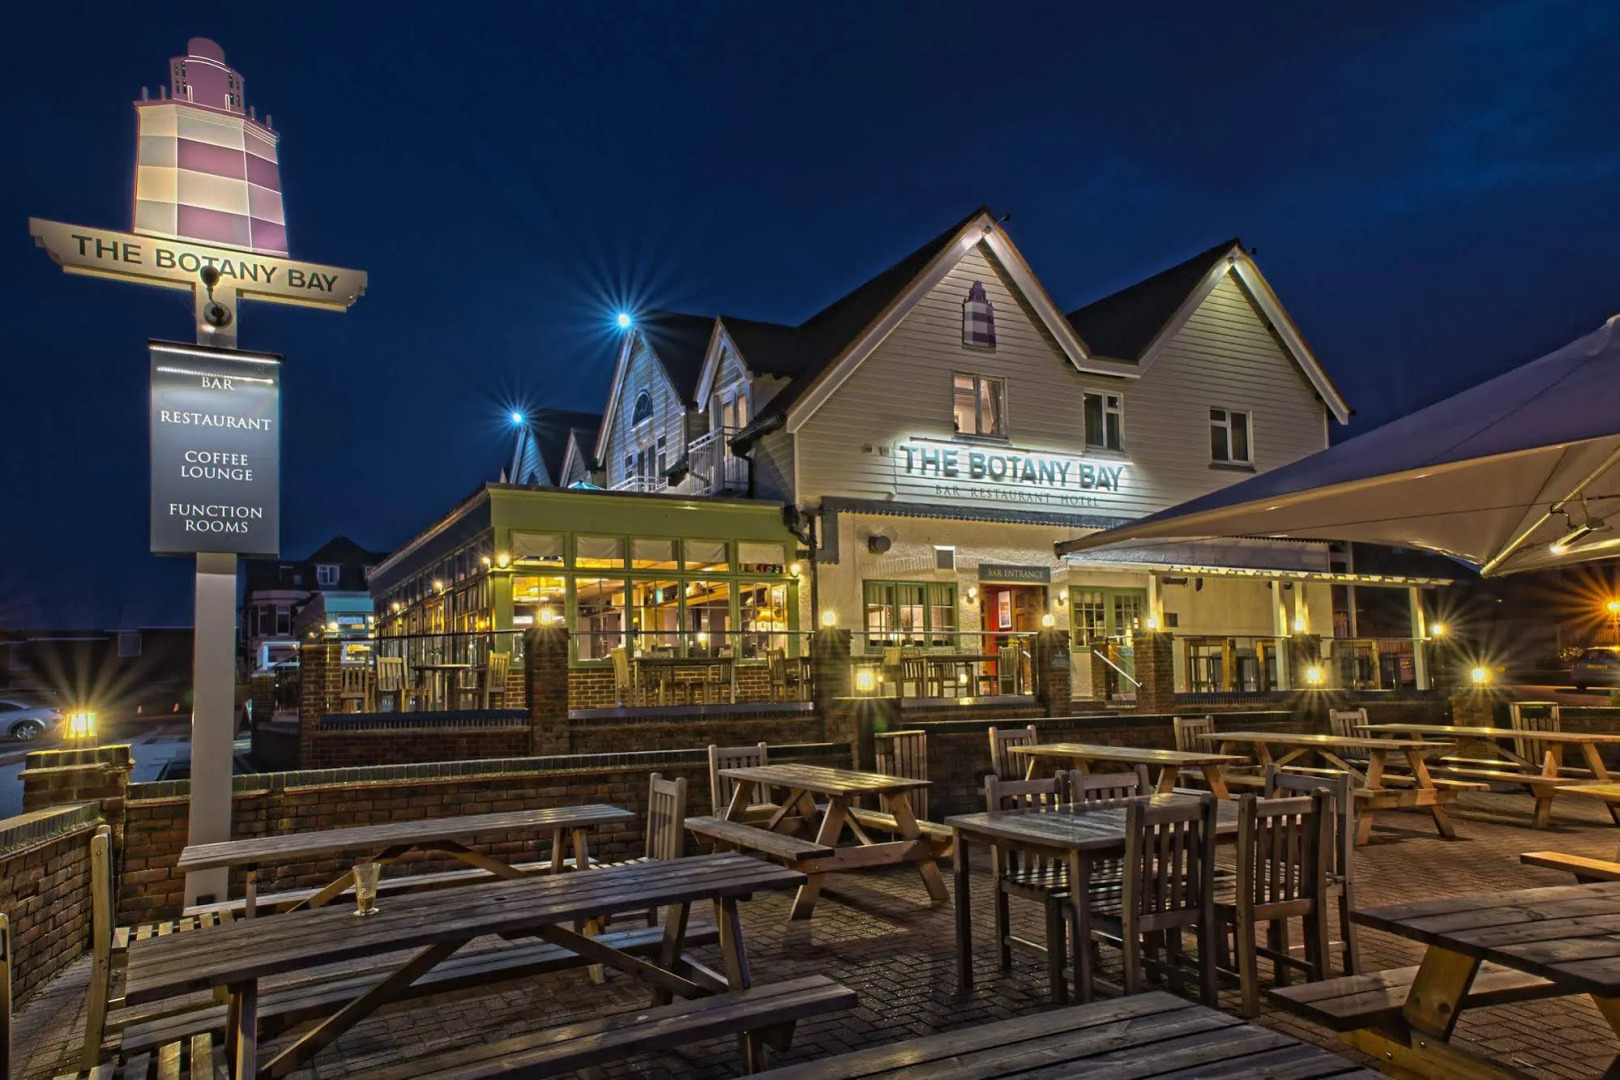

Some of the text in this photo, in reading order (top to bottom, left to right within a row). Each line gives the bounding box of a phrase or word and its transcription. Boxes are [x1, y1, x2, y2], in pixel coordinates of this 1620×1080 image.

[72, 234, 338, 293] THE BOTANY BAY
[201, 376, 235, 391] BAR
[160, 410, 272, 431] RESTAURANT
[185, 450, 248, 466] COFFEE
[181, 465, 253, 481] LOUNGE
[901, 446, 1123, 491] THE BOTANY BAY
[935, 484, 1100, 507] BAR RESTAURANT HOTEL
[169, 503, 263, 519] FUNCTION
[185, 519, 248, 534] ROOMS
[988, 569, 1044, 579] BAR ENTRANCE
